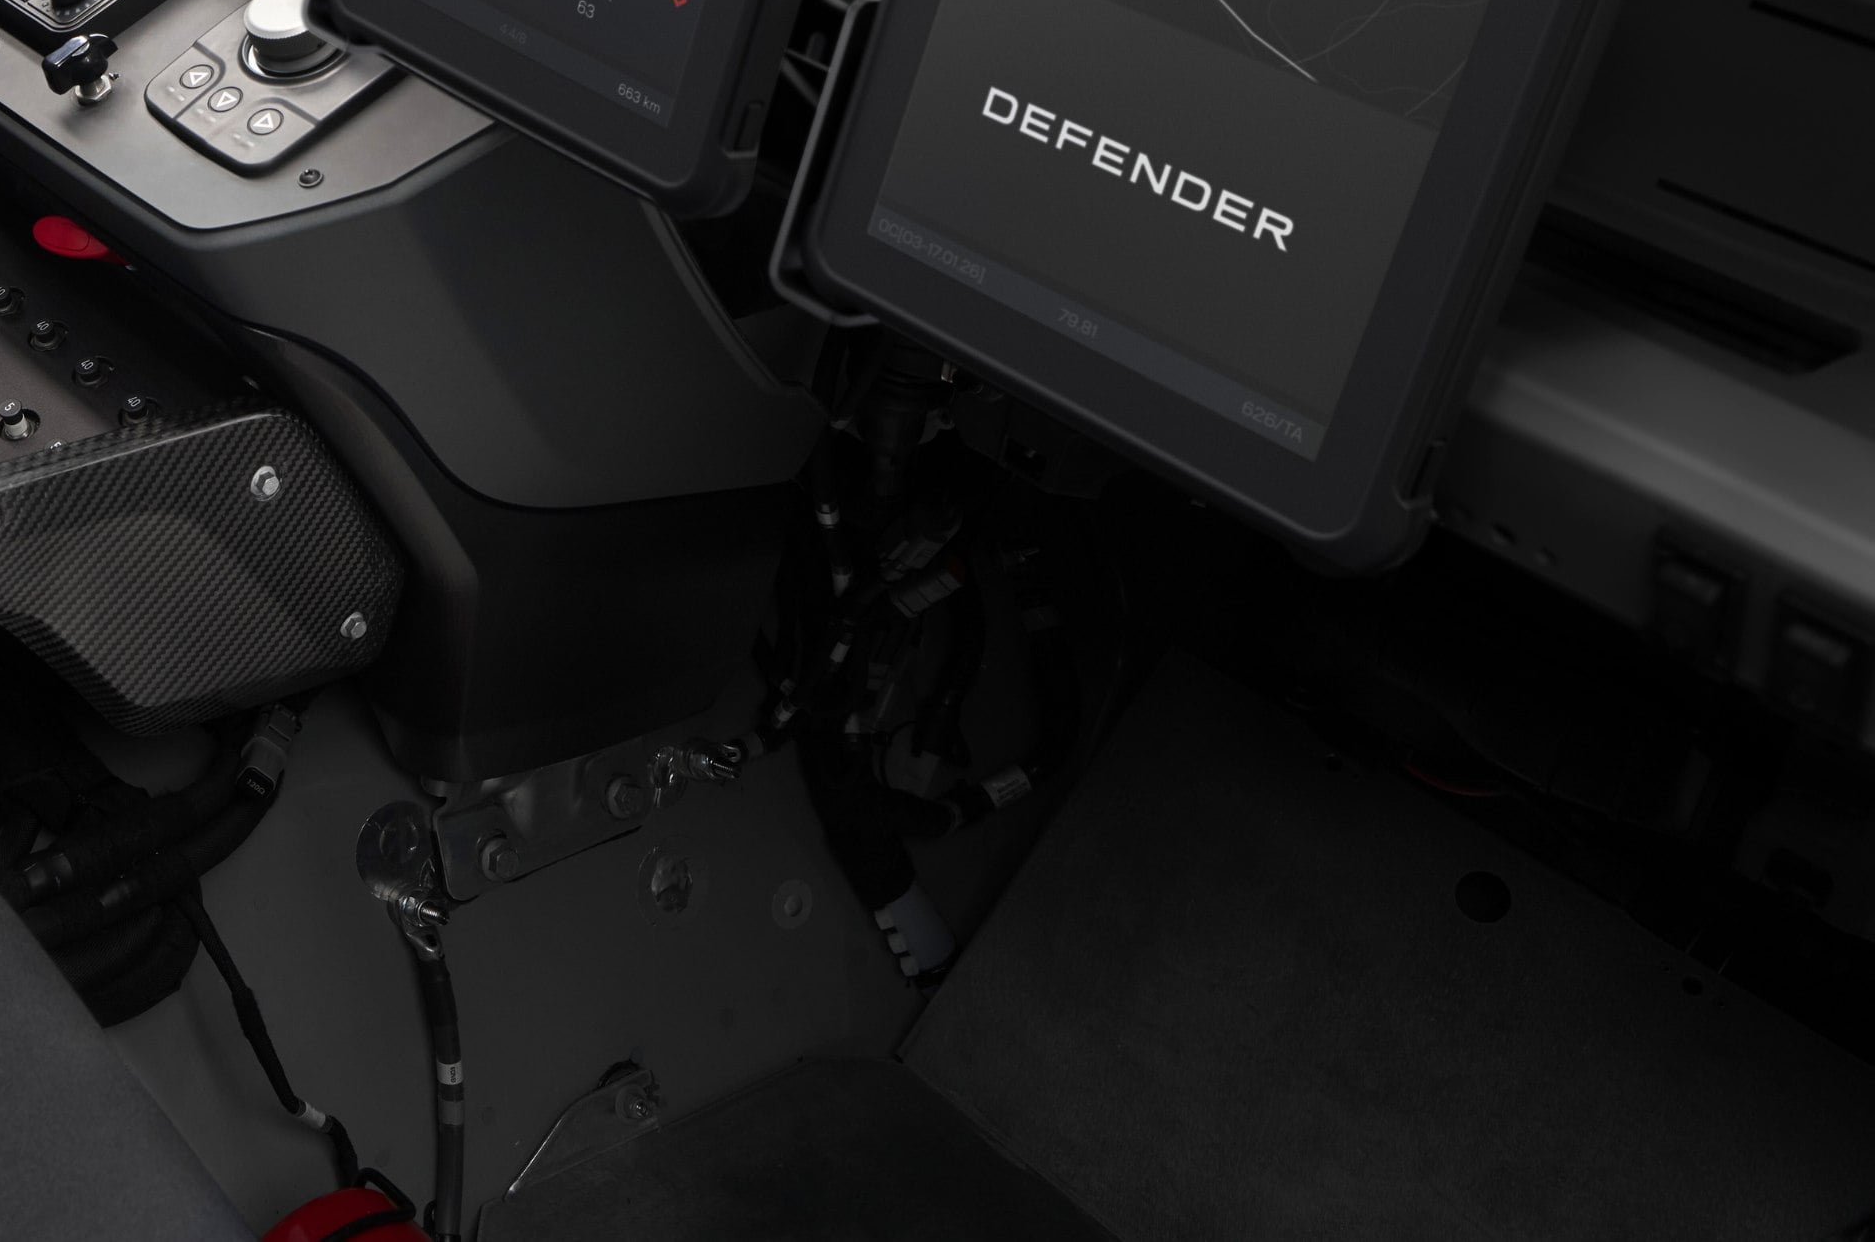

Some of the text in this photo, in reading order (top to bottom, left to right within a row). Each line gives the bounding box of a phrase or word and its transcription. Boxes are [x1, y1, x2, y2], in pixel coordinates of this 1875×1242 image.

[576, 0, 596, 20] 63
[618, 82, 662, 114] 663 km
[981, 85, 1295, 253] DEFENDER
[36, 321, 50, 331] 40
[80, 360, 93, 370] 40
[4, 402, 15, 412] 5
[127, 396, 141, 407] 40
